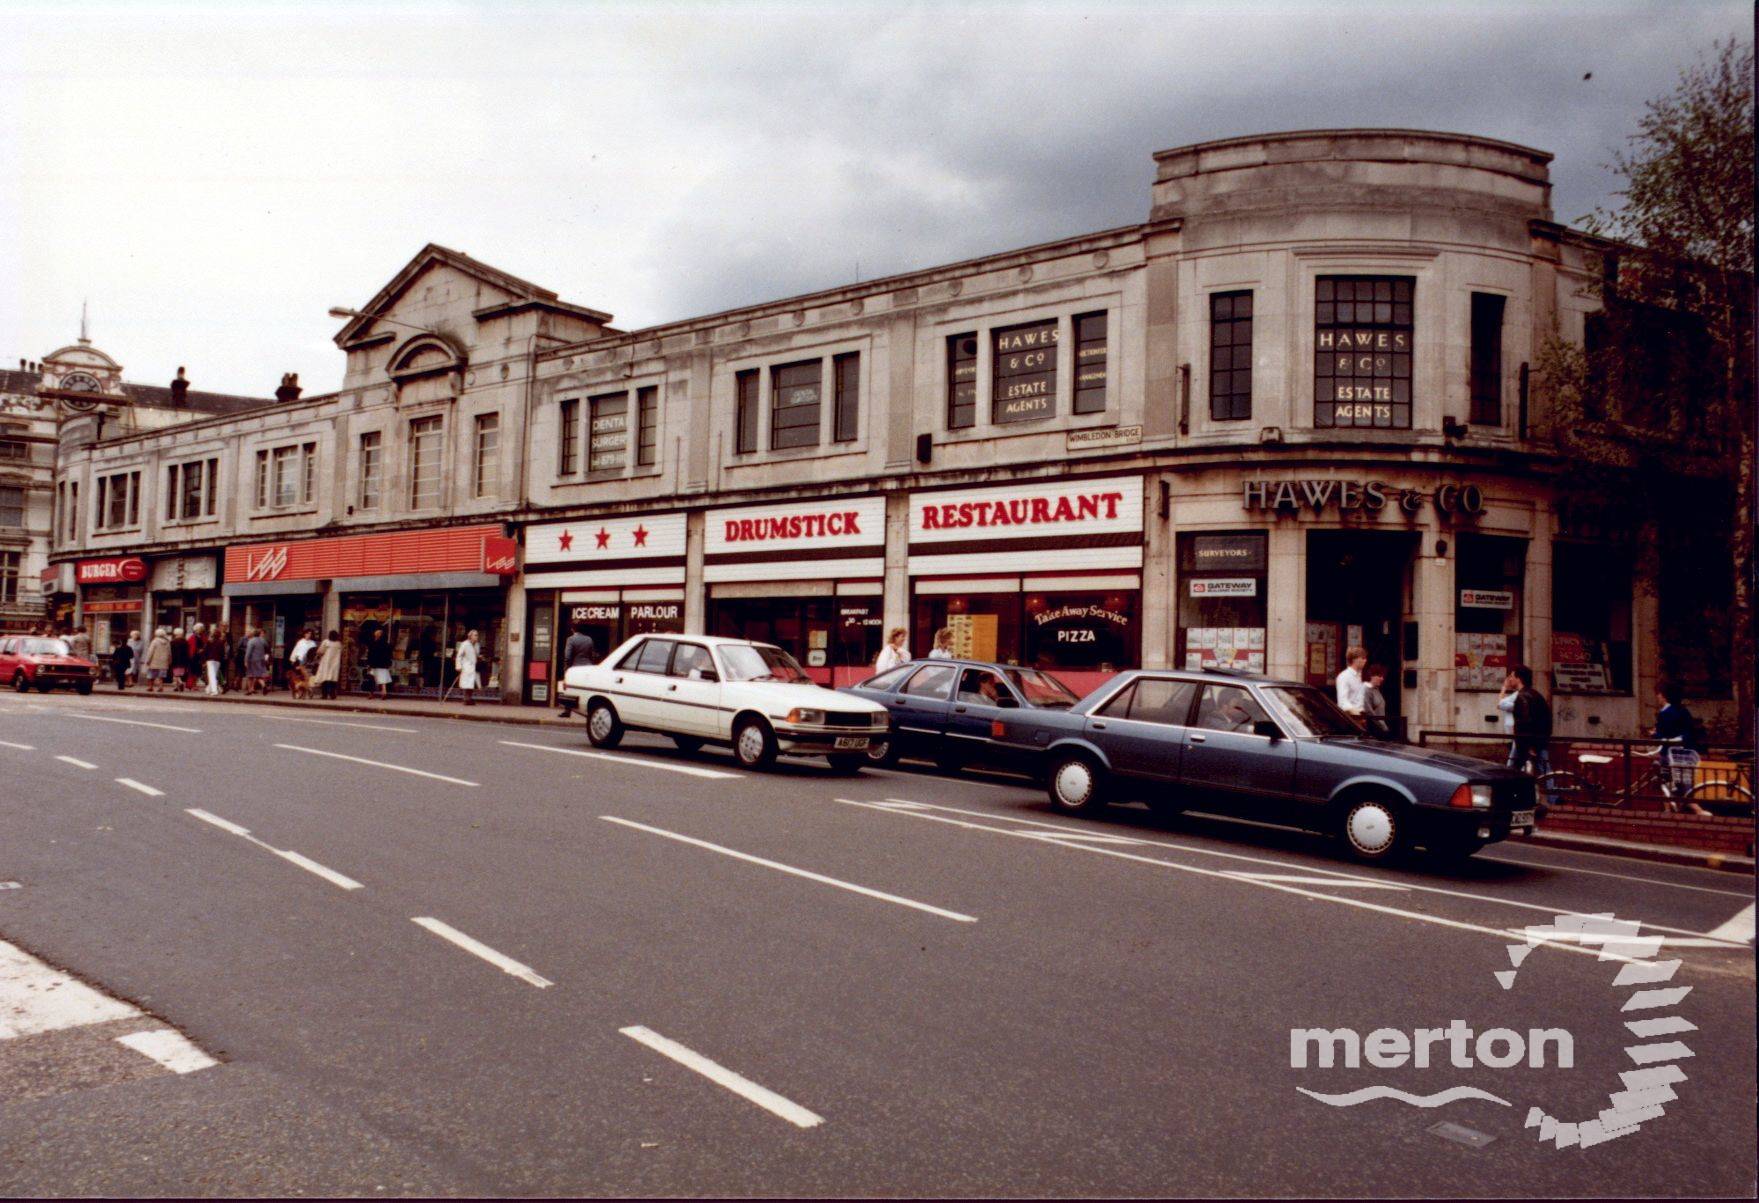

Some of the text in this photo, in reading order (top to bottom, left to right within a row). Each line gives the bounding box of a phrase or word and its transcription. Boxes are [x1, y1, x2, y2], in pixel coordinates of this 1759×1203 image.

[999, 329, 1061, 350] HAWES
[1319, 332, 1405, 347] HAWES
[1010, 357, 1020, 369] &
[1008, 381, 1047, 397] ESTATE
[1338, 386, 1390, 399] ESTATE
[1006, 398, 1047, 413] AGENTS
[1335, 405, 1391, 418] AGENTS
[592, 416, 626, 430] DENTA
[1069, 428, 1139, 442] WIMBLEDON BRIDGE
[1242, 479, 1483, 512] HAWES & CO
[921, 492, 1123, 530] RESTAURANT
[725, 511, 861, 542] DRUMSTICK
[1198, 549, 1248, 558] SURVEYORS
[81, 562, 117, 578] BURGER
[1475, 593, 1511, 601] GATEWAY
[631, 605, 678, 618] PARLOUR
[1034, 605, 1128, 626] Take Away Service
[1057, 630, 1096, 642] PIZZA
